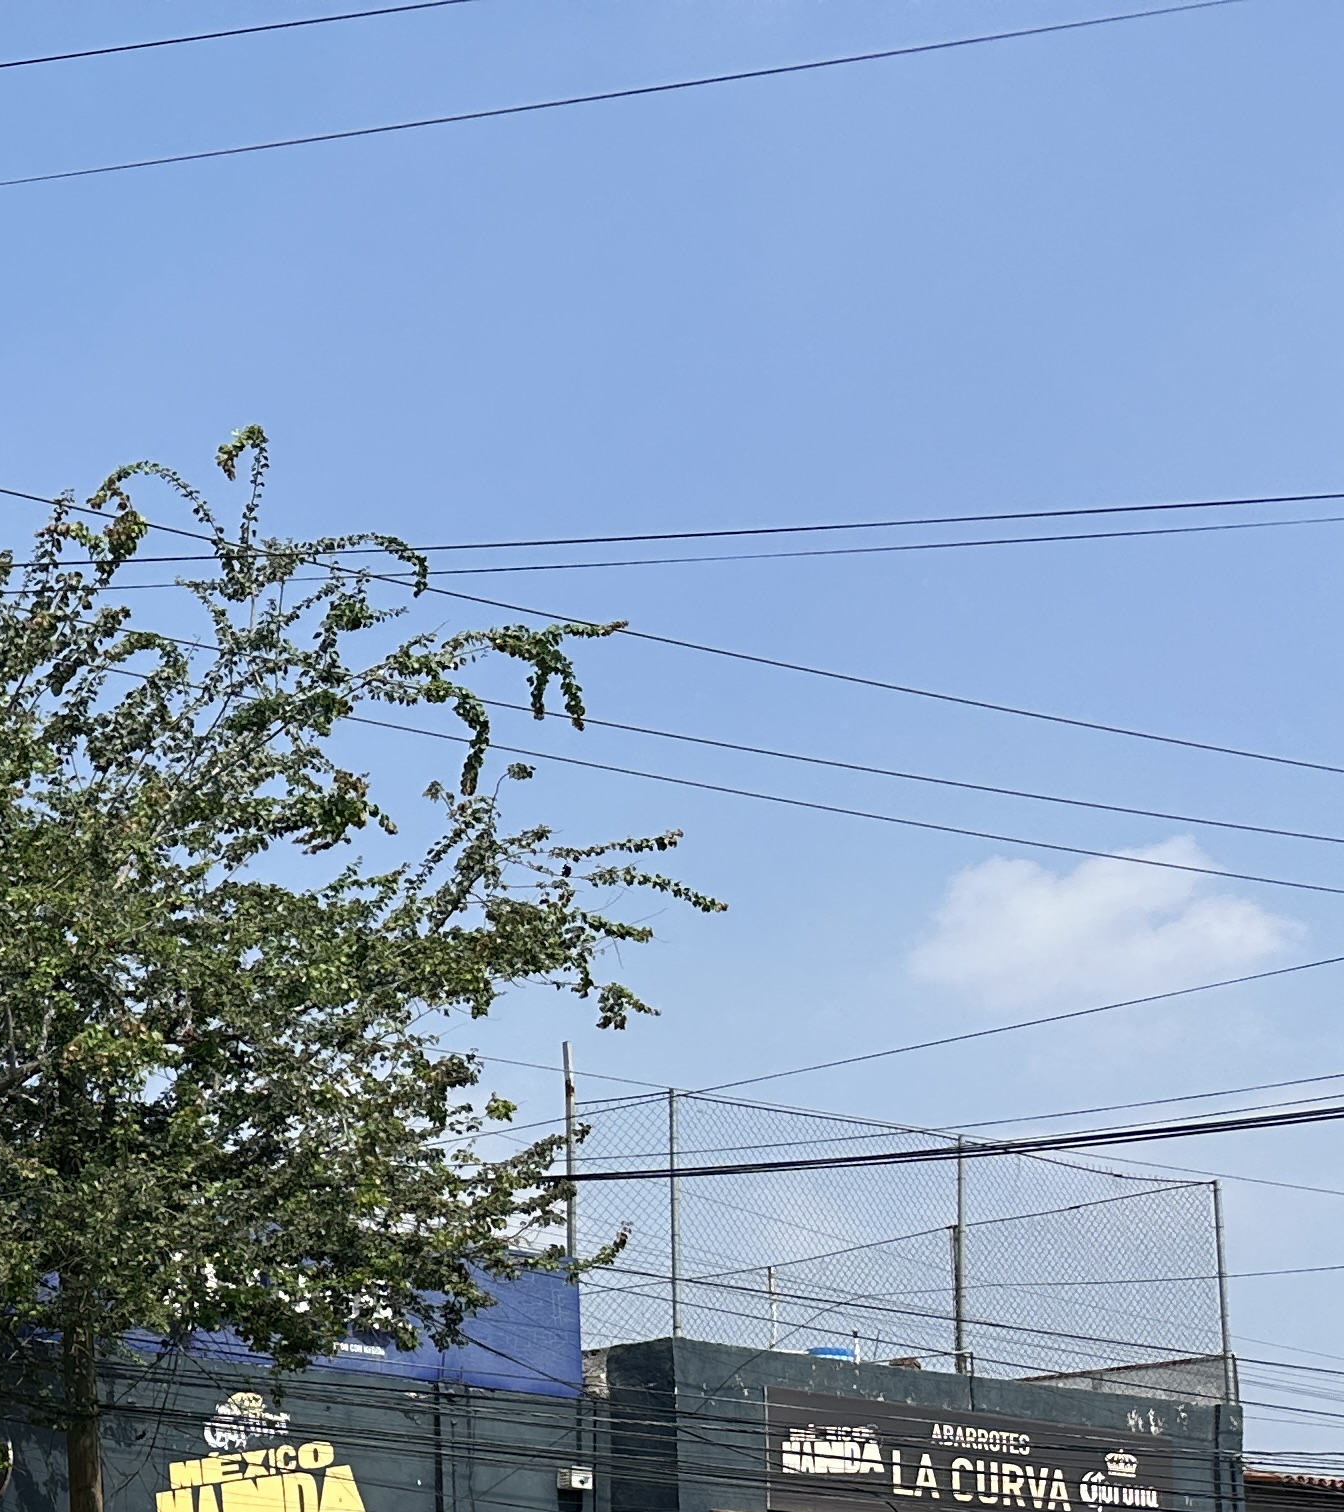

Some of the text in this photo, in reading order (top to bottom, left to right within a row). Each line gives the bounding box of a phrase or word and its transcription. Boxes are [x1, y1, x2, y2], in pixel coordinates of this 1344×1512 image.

[930, 1423, 1031, 1456] ABARROTES
[169, 1441, 334, 1490] MÉXICO
[891, 1449, 1072, 1512] LA CURVA
